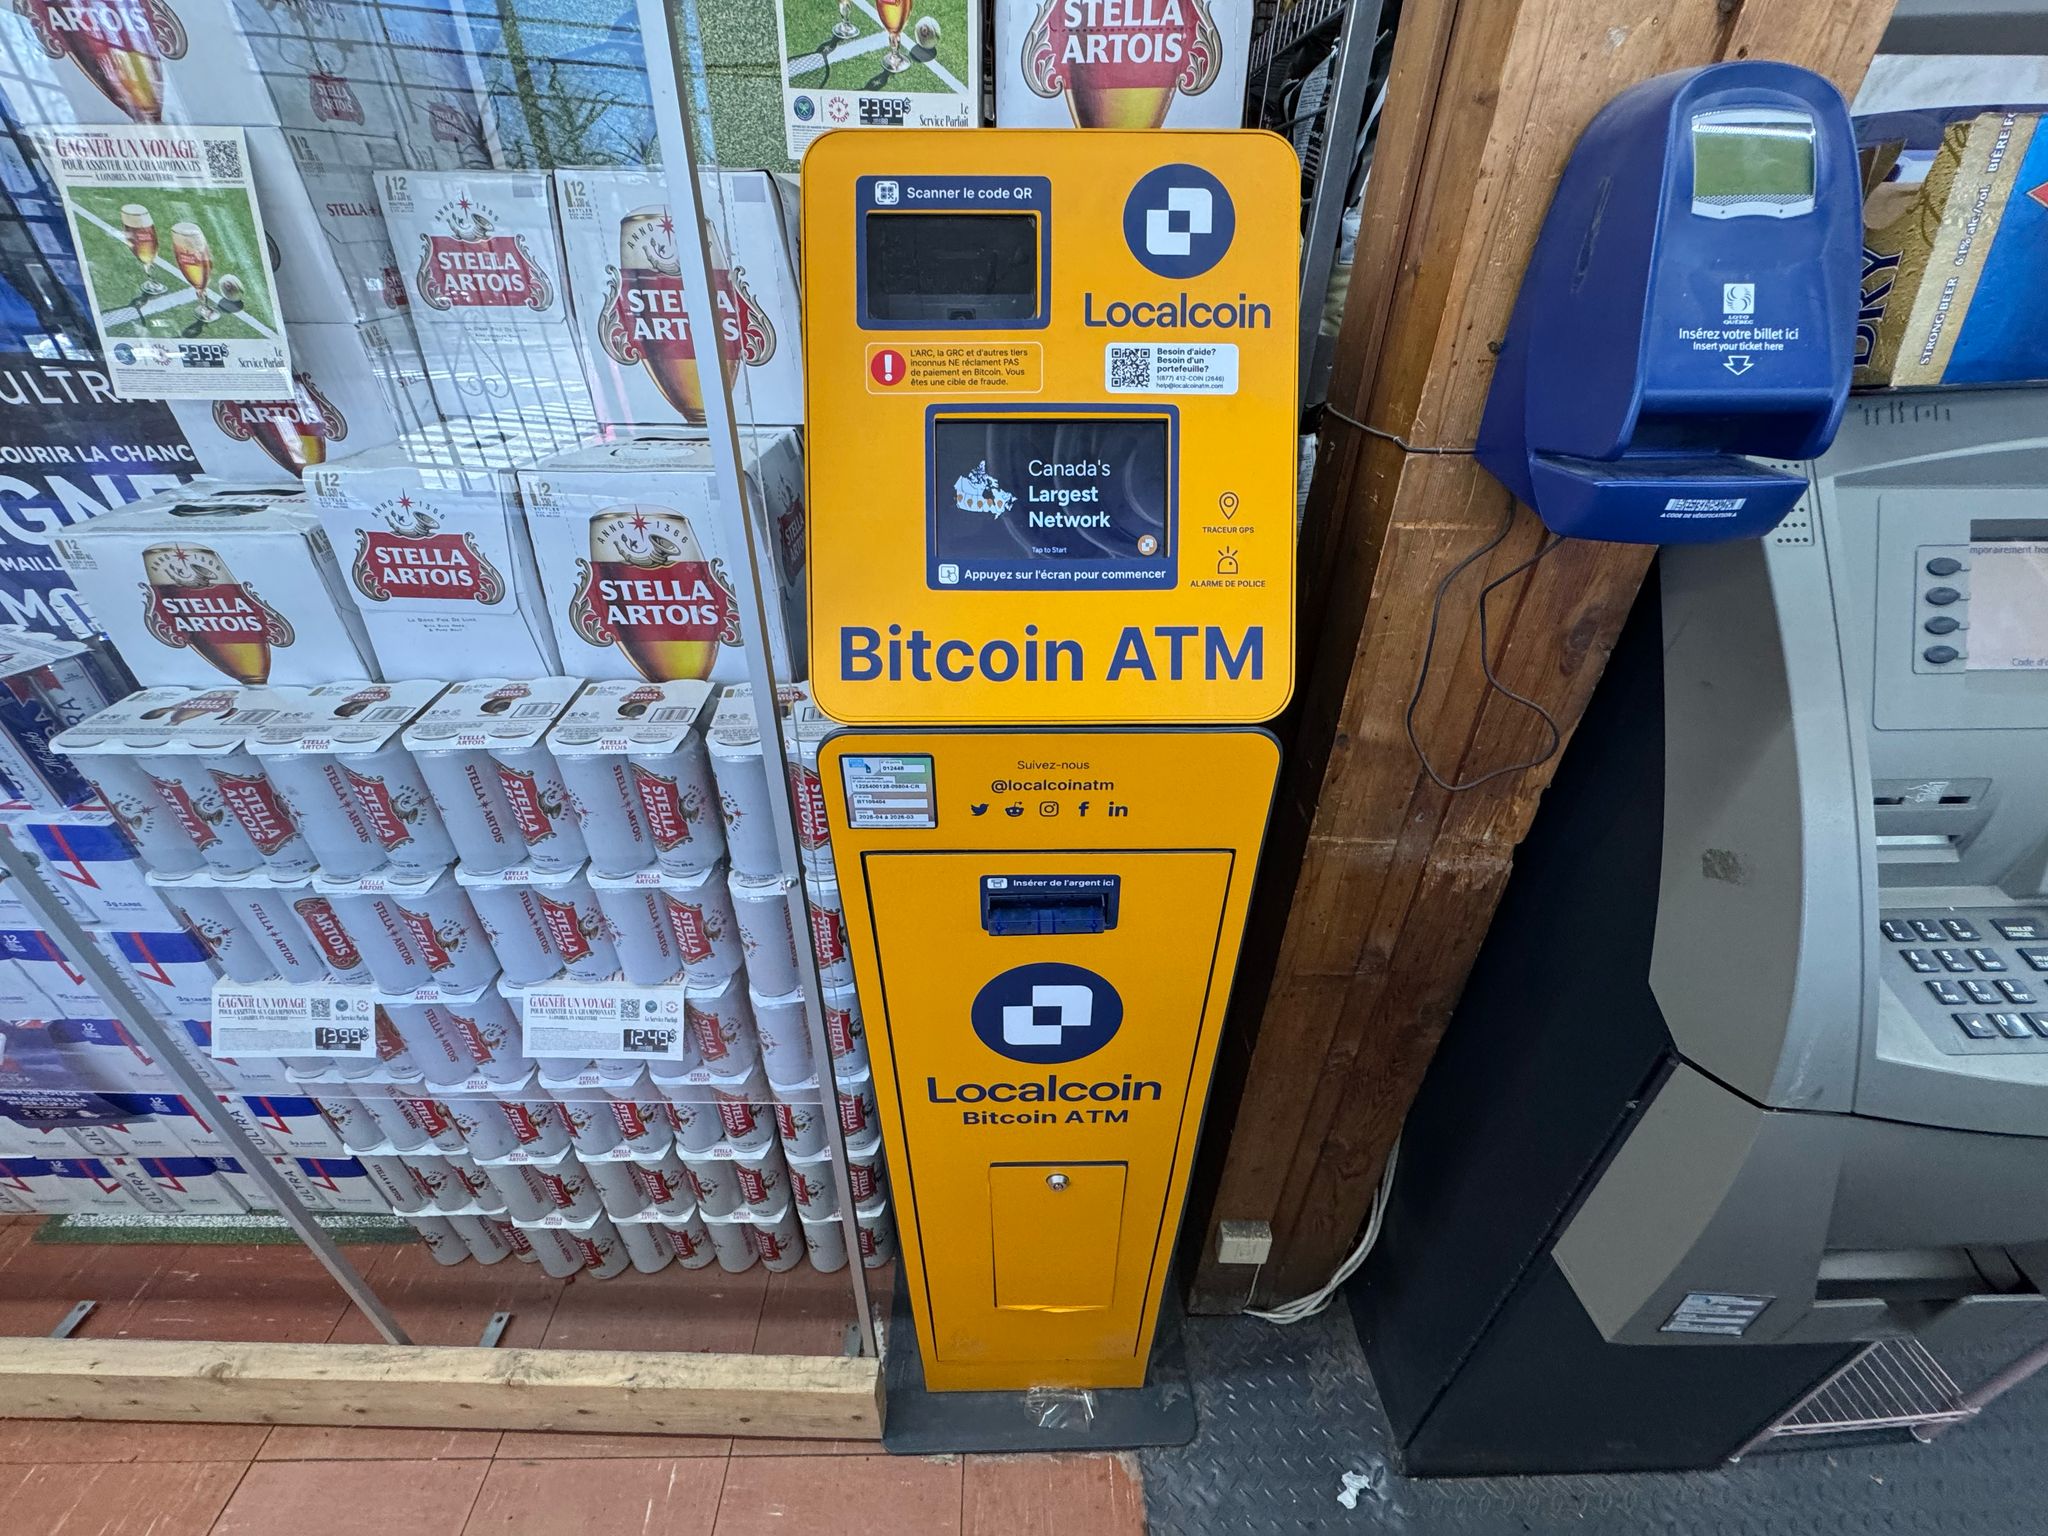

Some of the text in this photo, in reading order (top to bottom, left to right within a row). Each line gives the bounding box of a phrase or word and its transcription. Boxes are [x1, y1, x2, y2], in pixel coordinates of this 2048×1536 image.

[50, 7, 149, 32] ARTOIS
[1064, 0, 1184, 27] STELLA
[1061, 33, 1183, 63] ARTOIS
[919, 115, 969, 127] Service Parfait
[56, 138, 199, 159] GAGNER UN VOYAGE
[392, 176, 407, 190] 12
[570, 181, 586, 197] 12
[907, 186, 1033, 200] Scanner le code QR
[326, 203, 367, 217] STELLA
[626, 223, 654, 249] ANNO
[1919, 309, 1946, 366] STRONG
[1938, 276, 1958, 312] BEER
[1987, 124, 2010, 174] BIÈRE
[438, 252, 520, 271] STELLA
[444, 273, 525, 292] ARTOIS
[1084, 293, 1271, 329] Localcoin
[1679, 327, 1799, 340] Insérez votre billet ici
[910, 350, 936, 358] L'ARC,
[946, 349, 964, 357] GRC
[977, 349, 1008, 357] d'autres
[1187, 348, 1217, 356] d'aide?
[1693, 341, 1784, 352] Insert your ticket here
[238, 357, 262, 368] Service
[911, 359, 946, 367] inconnus
[962, 357, 1001, 366] réclament
[1003, 358, 1020, 366] PAS
[1156, 365, 1209, 373] portefeuille?
[910, 369, 920, 377] de
[923, 368, 959, 378] paiement
[974, 368, 1003, 376] Bitcoin.
[910, 378, 928, 386] êtes
[947, 378, 965, 386] cible
[968, 378, 979, 386] de
[980, 378, 1009, 386] fraude.
[76, 446, 110, 462] LA
[1028, 459, 1111, 477] Canada's
[322, 473, 340, 487] 12
[537, 482, 551, 496] 12
[1029, 486, 1098, 507] Largest
[370, 500, 394, 518] ANNO
[1029, 511, 1111, 528] Network
[597, 520, 689, 545] ANNO 1366
[1202, 526, 1255, 534] TRACEUR GPS
[66, 540, 79, 550] 12
[375, 547, 469, 566] STELLA
[382, 568, 474, 587] ARTOIS
[964, 570, 1013, 581] Appuyez
[1036, 569, 1072, 580] l'écran
[1074, 571, 1099, 581] pour
[1101, 570, 1167, 580] commencer
[599, 580, 713, 601] STELLA
[1190, 580, 1266, 588] ALARME DE POLICE
[162, 598, 254, 614] STELLA
[607, 605, 719, 625] ARTOIS
[175, 616, 263, 632] ARTOIS
[840, 623, 1265, 682] Bitcoin ATM
[1017, 760, 1090, 770] Suivez-nous
[323, 764, 348, 801] STELLA
[465, 764, 486, 801] STELLA
[613, 764, 628, 801] STELLA
[991, 779, 1115, 794] @localcoinatm
[240, 786, 281, 839] STELLA
[359, 786, 396, 838] STELLA
[511, 780, 540, 832] STELLA
[640, 782, 662, 838] ARTOIS
[653, 785, 674, 838] STELLA
[1013, 879, 1114, 888] Insérer de l'argent ici
[1916, 921, 1928, 932] 2
[1949, 920, 1960, 931] 3
[313, 911, 350, 958] ARTOIS
[1941, 950, 1953, 961] 5
[1974, 950, 1986, 961] 6
[1933, 982, 1943, 993] 7
[1967, 981, 1979, 992] 8
[2003, 981, 2015, 992] 9
[218, 998, 306, 1010] GAGNER UN VOYAGE
[530, 997, 616, 1009] GAGNER UN VOYAGE
[926, 1073, 1162, 1104] Localcoin
[963, 1110, 1129, 1125] Bitcoin ATM
